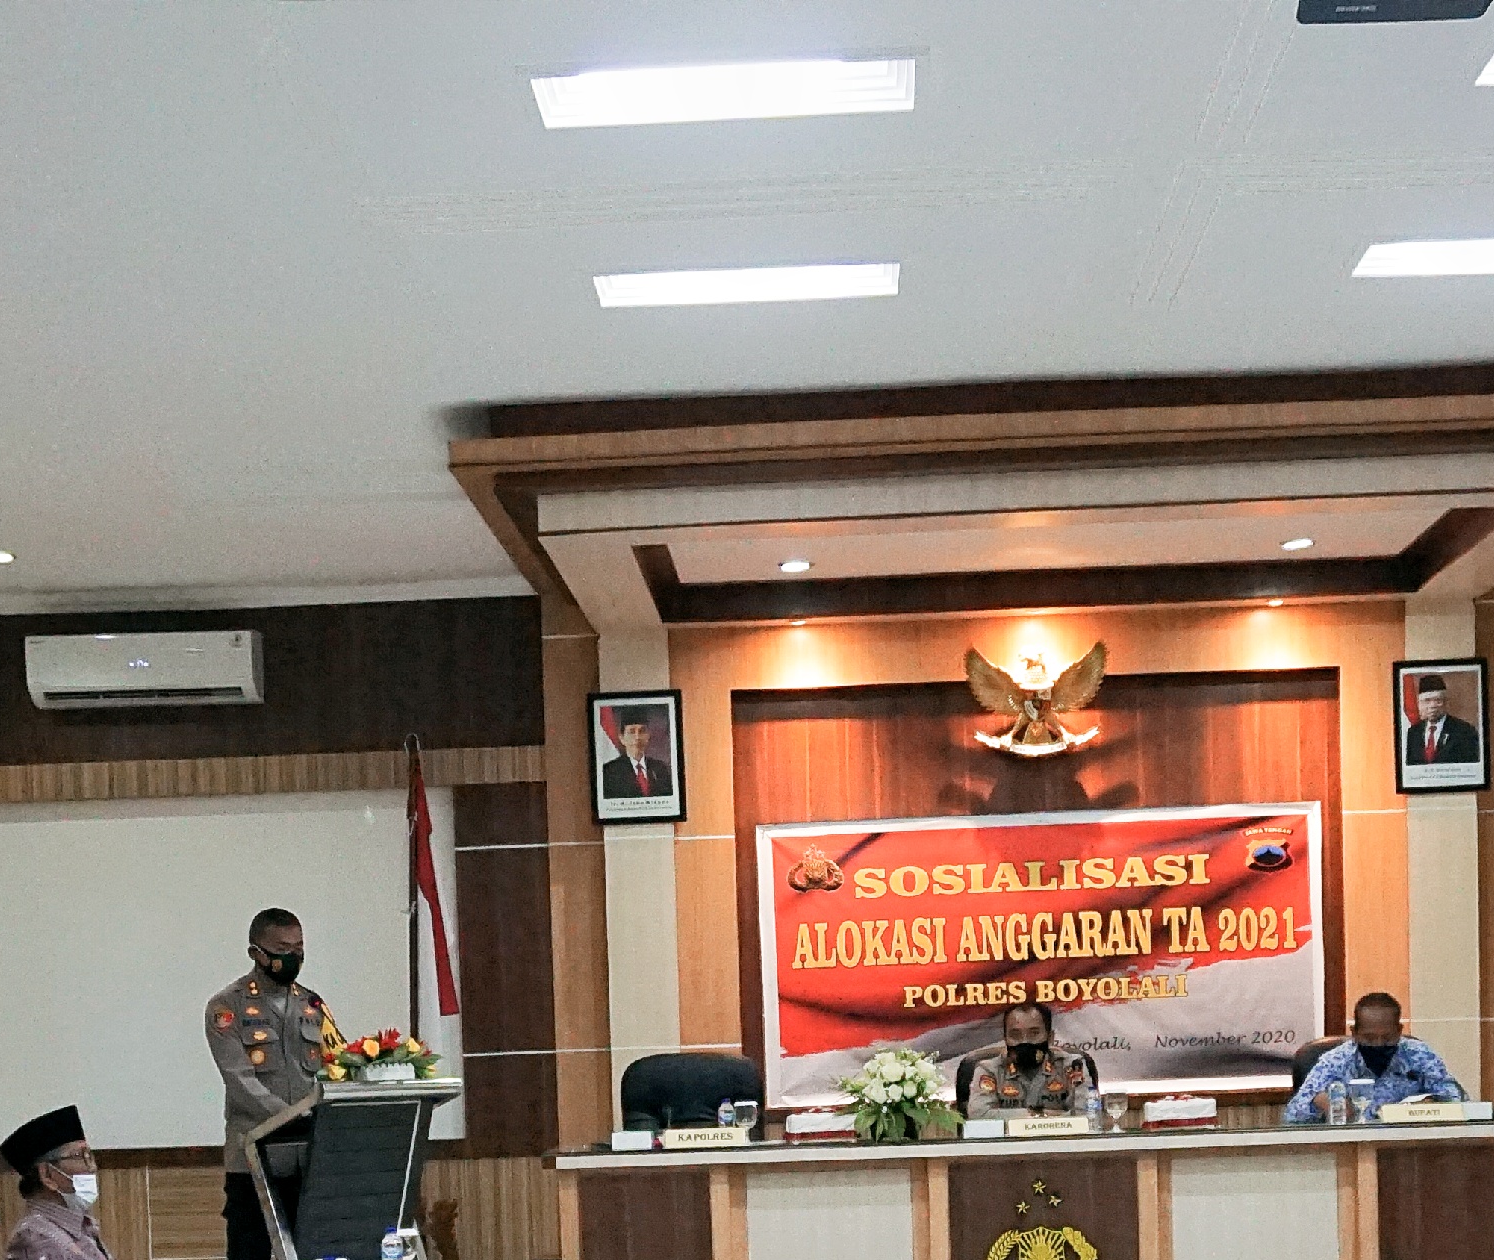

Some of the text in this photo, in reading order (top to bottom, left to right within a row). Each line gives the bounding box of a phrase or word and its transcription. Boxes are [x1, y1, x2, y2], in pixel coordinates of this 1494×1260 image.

[853, 853, 1211, 899] SOSIALISASI
[791, 906, 1298, 970] ALOKASI ANGGARAN TA 2021
[903, 974, 1189, 1008] POLRES BOYOLALI
[1155, 1031, 1247, 1049] November
[1251, 1029, 1296, 1045] 2020
[677, 1131, 734, 1143] KAPOLRES
